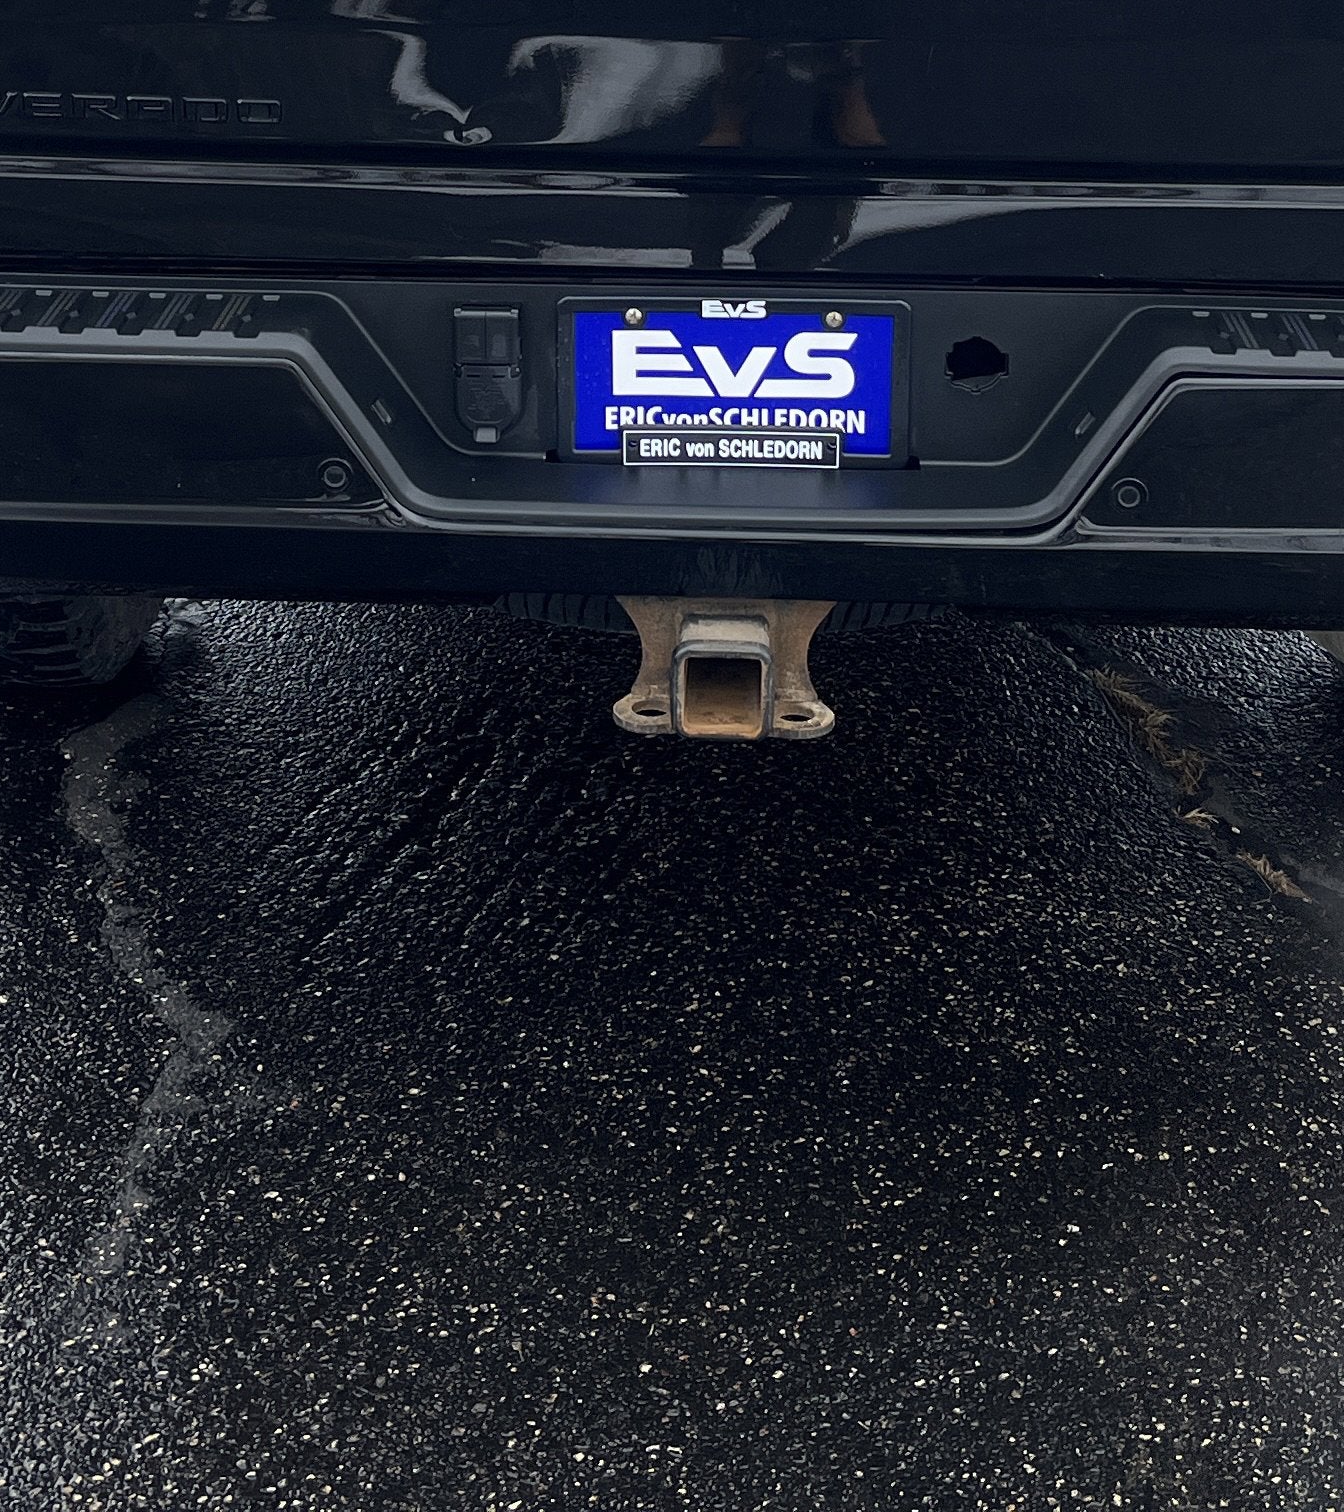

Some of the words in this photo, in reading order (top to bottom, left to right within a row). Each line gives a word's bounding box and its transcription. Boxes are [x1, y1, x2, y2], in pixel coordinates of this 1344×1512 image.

[639, 438, 681, 458] ERIC
[685, 442, 715, 459] von
[718, 439, 824, 461] SCHLEDORN
